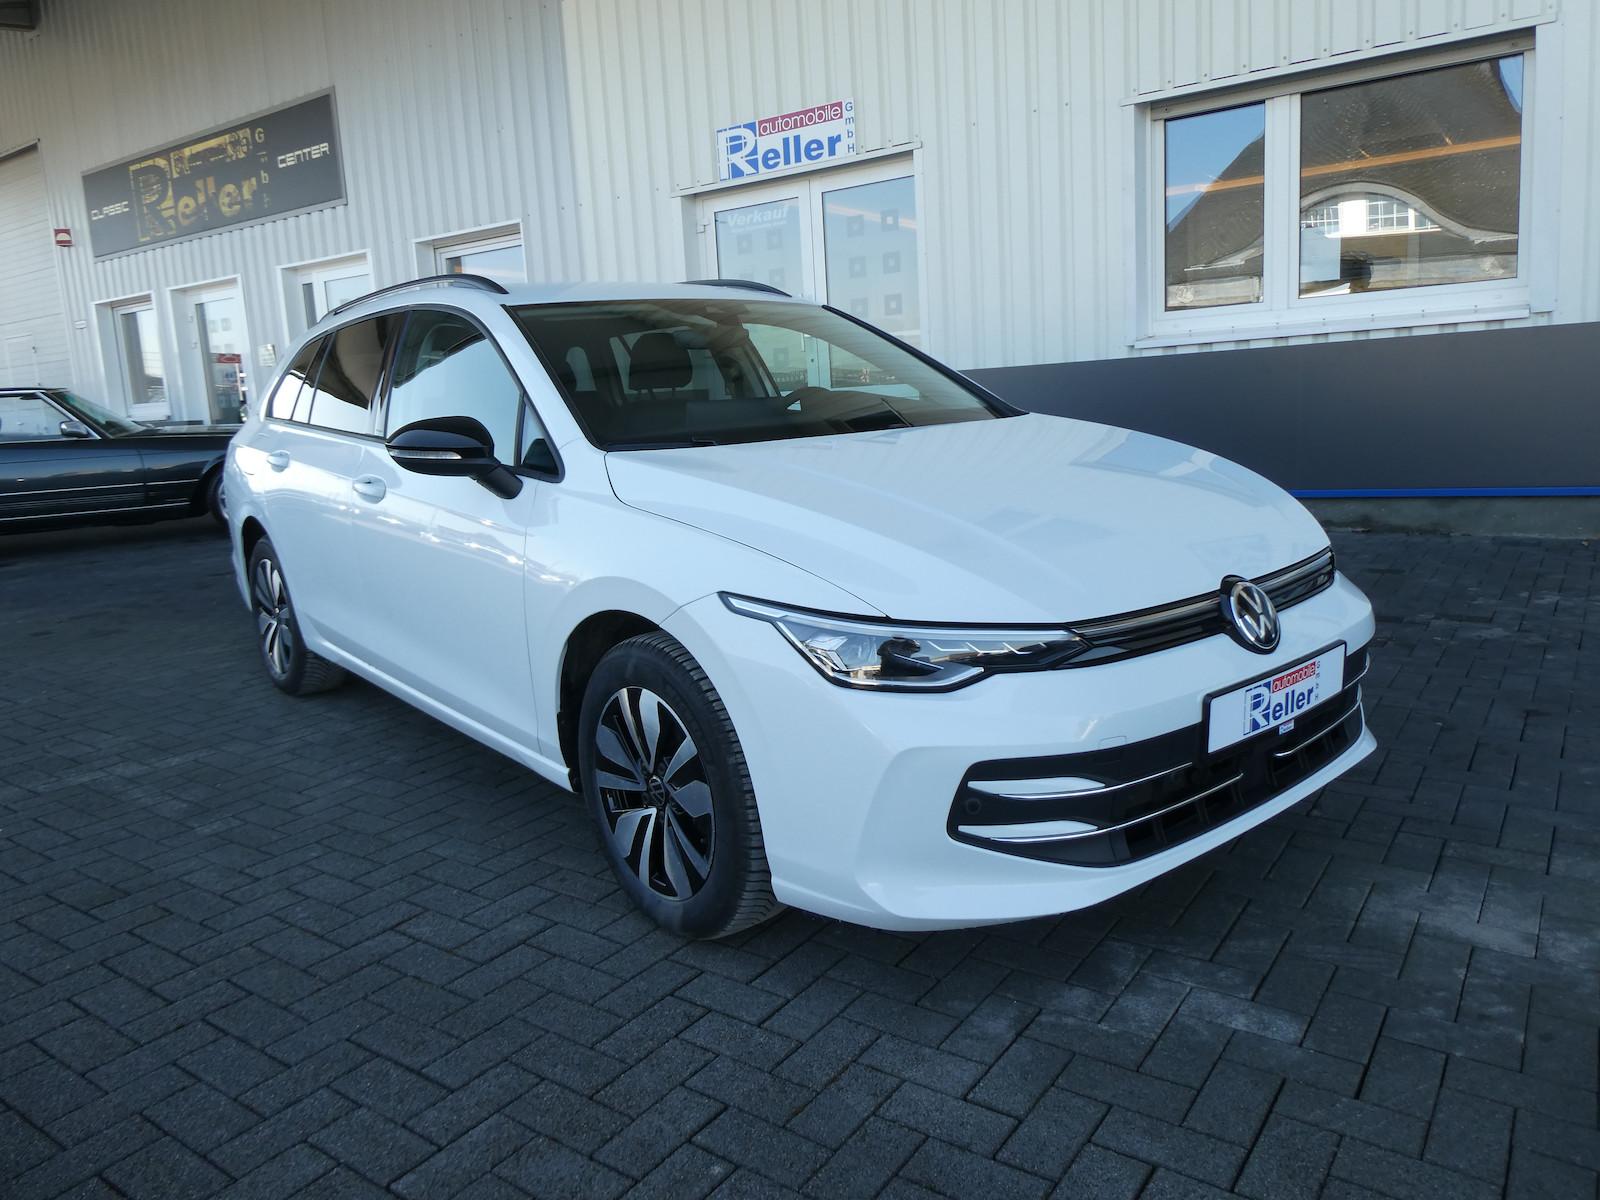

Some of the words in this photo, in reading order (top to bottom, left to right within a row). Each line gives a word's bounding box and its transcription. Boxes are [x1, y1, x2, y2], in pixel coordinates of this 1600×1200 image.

[760, 104, 842, 136] automobile
[844, 101, 855, 154] GmbH
[277, 142, 330, 168] CENTER
[718, 124, 842, 181] Reller
[728, 207, 789, 226] Verkauf
[1272, 664, 1316, 691] automobile
[1244, 684, 1314, 735] Reller
